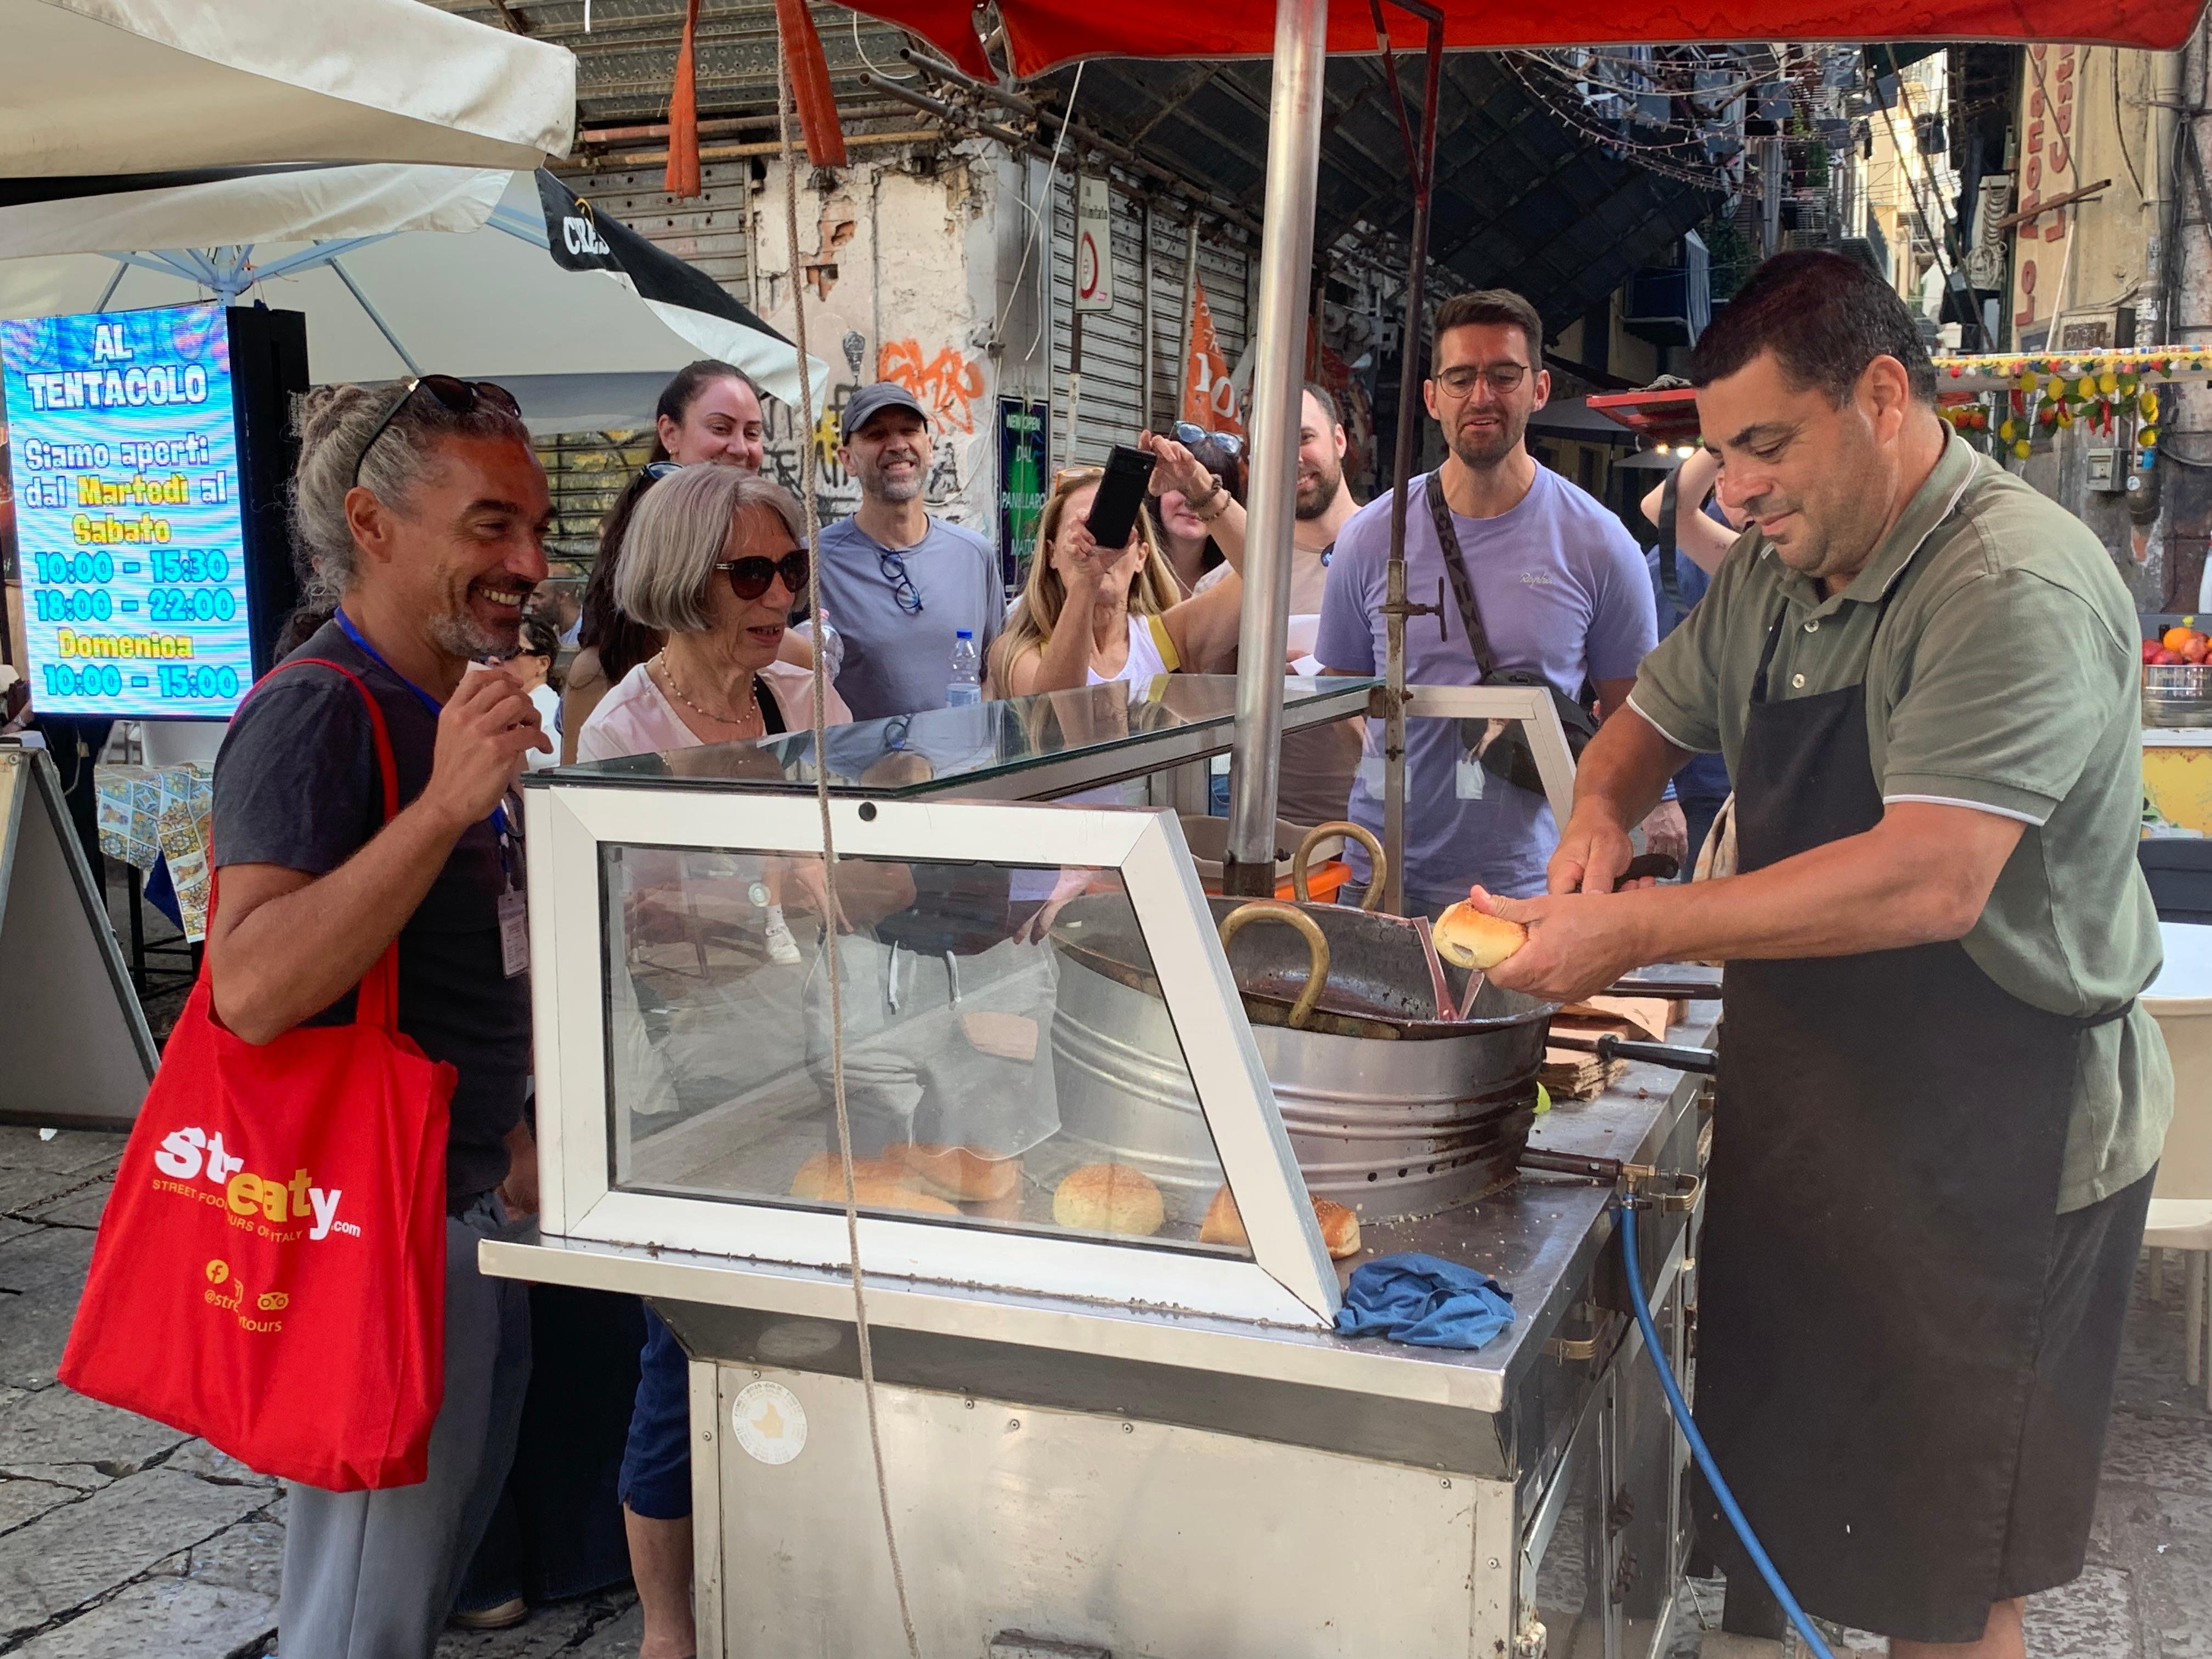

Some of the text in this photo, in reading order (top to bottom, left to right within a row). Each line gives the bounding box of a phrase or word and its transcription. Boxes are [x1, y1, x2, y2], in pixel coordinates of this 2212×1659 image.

[2015, 259, 2036, 326] Lo
[93, 323, 134, 363] AL
[25, 364, 208, 411] TENTACOLO
[24, 431, 210, 475] Siamo aperti
[25, 470, 227, 508] dal Martedì al
[72, 512, 172, 545] Sabato
[35, 551, 114, 584] 10:00
[150, 549, 229, 583] 15:30
[34, 589, 112, 621] 18:00
[148, 588, 236, 621] 22:00
[43, 664, 122, 696] 10:00
[157, 664, 239, 698] 15:00
[153, 1179, 197, 1199] STREET
[198, 1192, 228, 1210] FOO
[270, 1230, 303, 1243] ITALY
